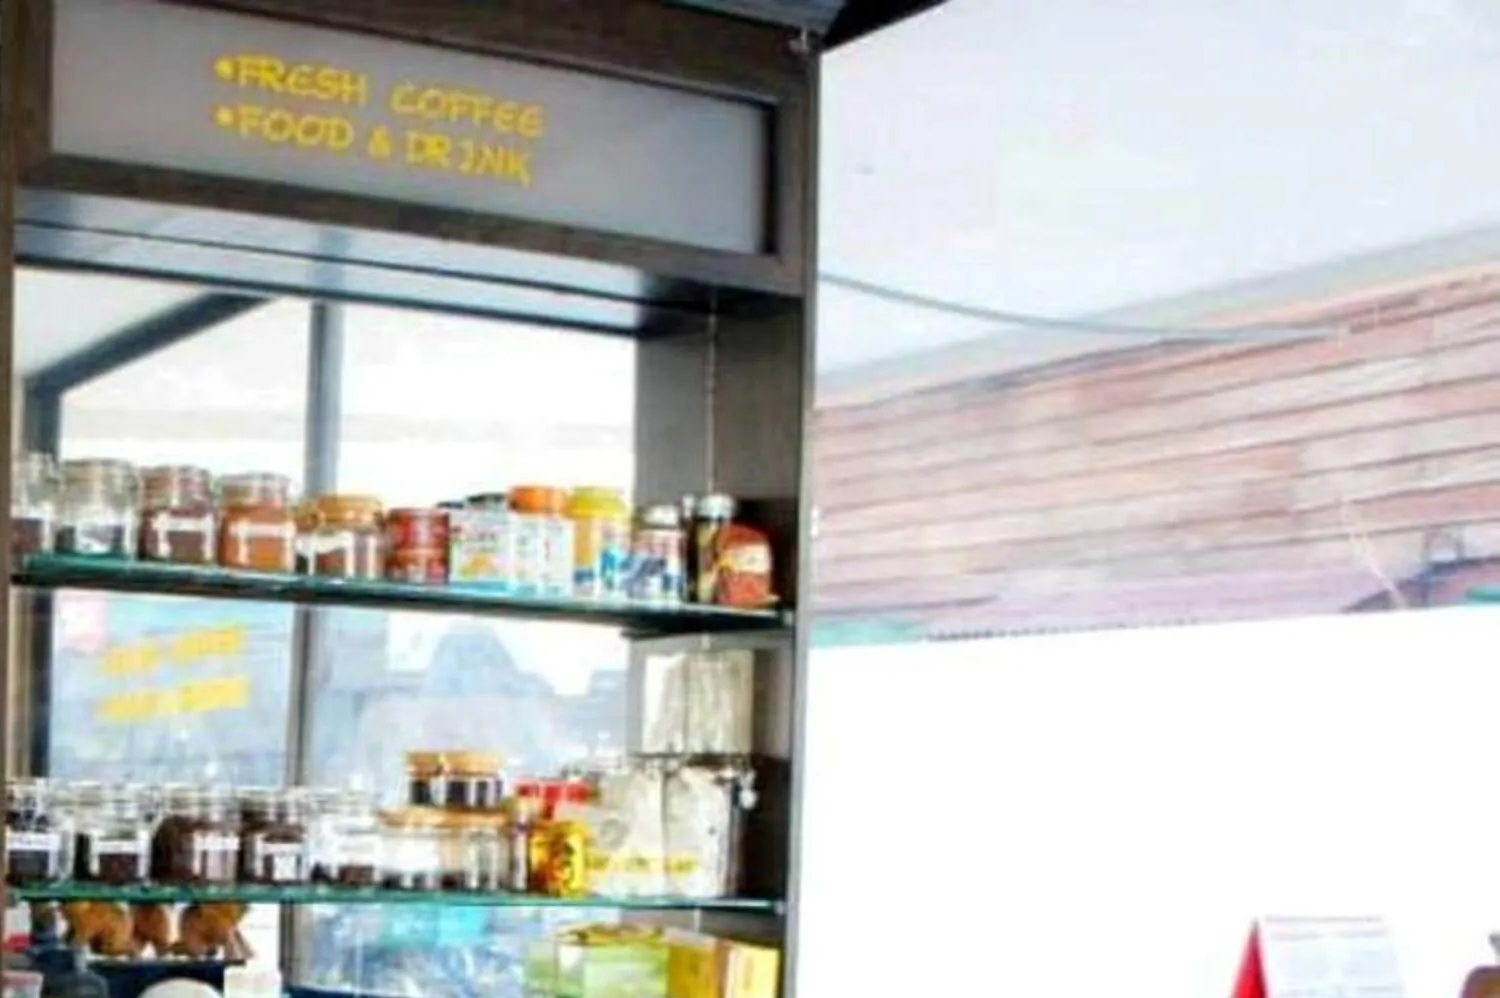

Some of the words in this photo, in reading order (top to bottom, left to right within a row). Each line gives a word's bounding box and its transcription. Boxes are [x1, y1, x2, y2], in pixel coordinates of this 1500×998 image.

[236, 104, 355, 156] FOOD
[237, 56, 368, 106] FRESH
[391, 80, 544, 138] COFFEE
